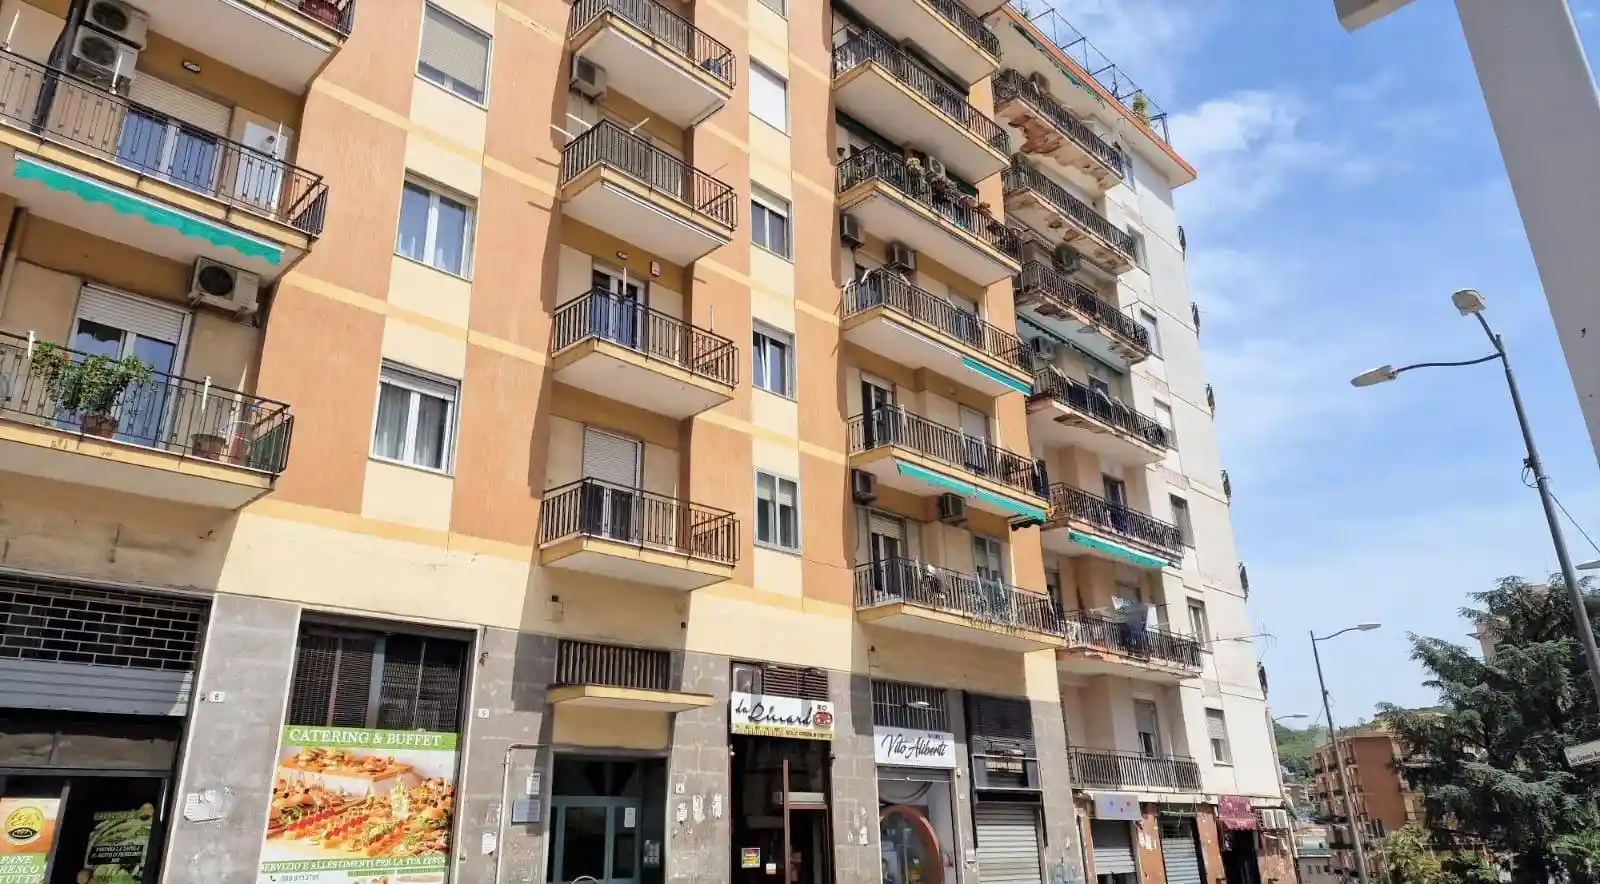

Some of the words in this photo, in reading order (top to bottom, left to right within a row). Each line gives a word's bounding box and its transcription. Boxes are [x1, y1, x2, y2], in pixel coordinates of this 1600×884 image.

[736, 699, 749, 713] da
[289, 728, 369, 744] CATERING
[373, 732, 382, 744] &
[387, 733, 442, 747] BUFFET
[881, 733, 908, 757] Vito
